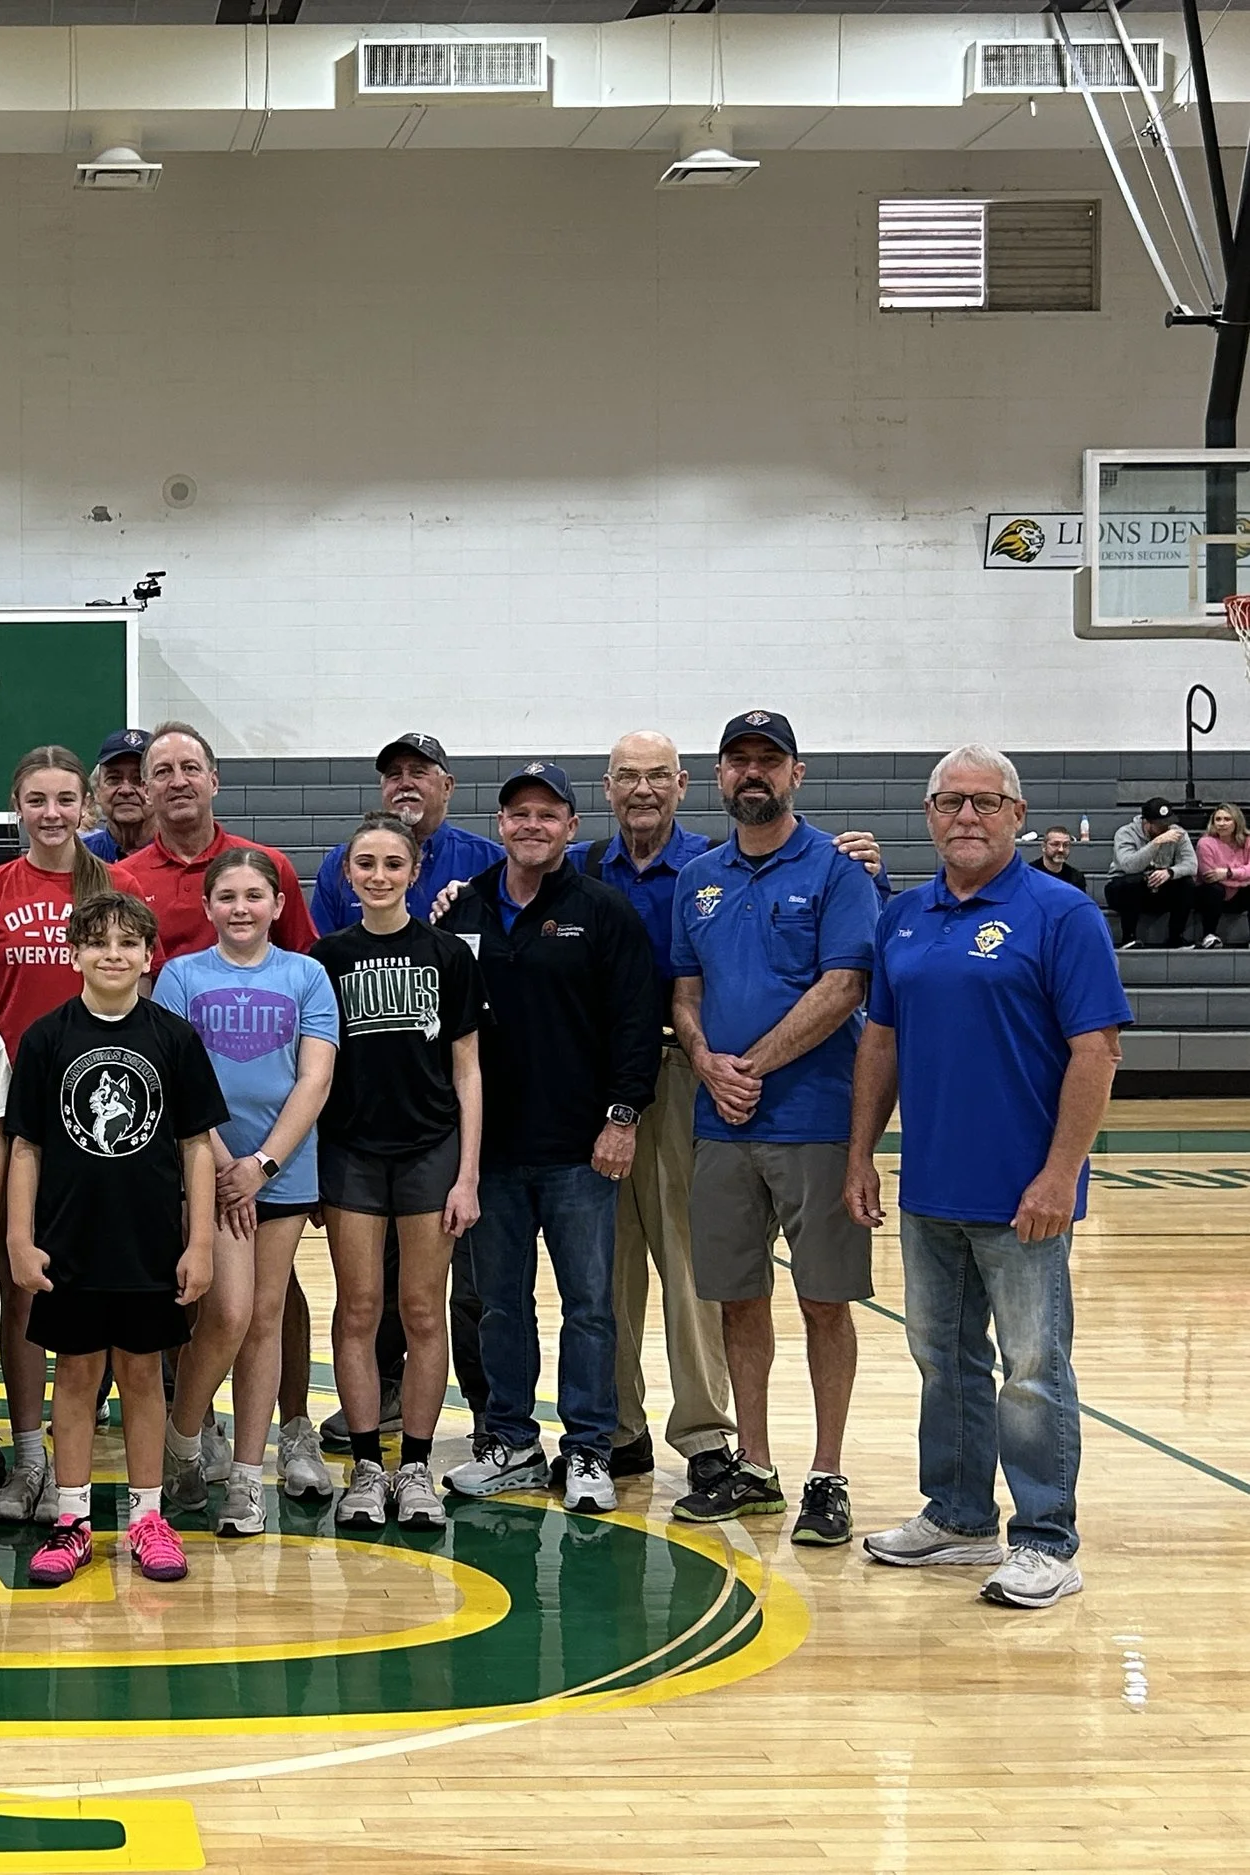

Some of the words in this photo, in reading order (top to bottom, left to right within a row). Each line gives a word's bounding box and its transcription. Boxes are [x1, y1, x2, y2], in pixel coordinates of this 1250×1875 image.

[1057, 520, 1141, 545] LINS
[3, 901, 74, 932] OUTLA
[43, 925, 67, 944] VS
[4, 946, 71, 966] EVERYB
[354, 956, 411, 971] MAUREPAS
[338, 965, 440, 1022] WOLVES
[201, 1003, 286, 1035] JOELITE
[122, 1053, 160, 1093] SCHOOL
